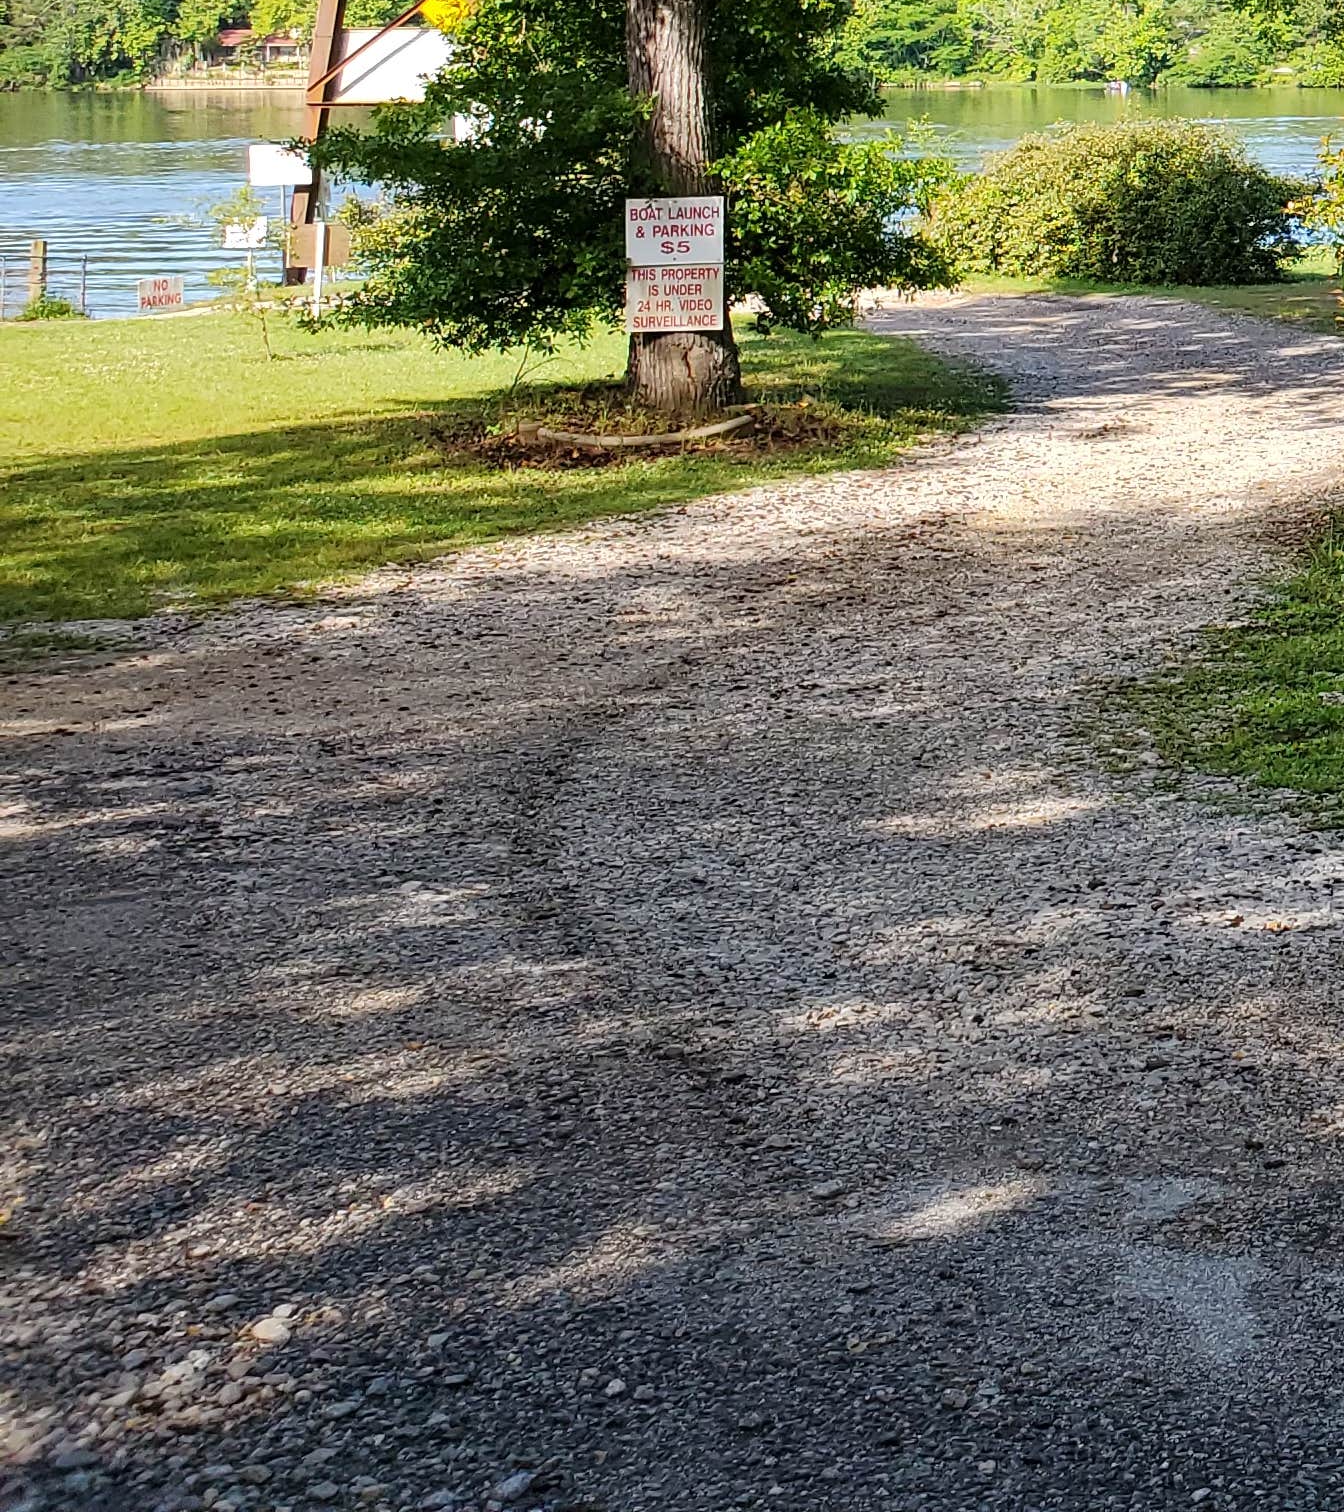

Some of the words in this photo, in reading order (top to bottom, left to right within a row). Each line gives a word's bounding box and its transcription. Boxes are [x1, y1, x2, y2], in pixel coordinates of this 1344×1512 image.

[630, 207, 663, 221] BOAT
[668, 206, 719, 220] LAUNCH
[636, 226, 645, 238] &
[653, 224, 714, 237] PARKING
[661, 241, 690, 254] $5
[632, 269, 656, 281] THIS
[662, 268, 719, 281] PROPERTY
[154, 279, 168, 291] NO
[649, 285, 659, 296] IS
[664, 284, 702, 296] UNDER
[141, 293, 181, 308] PARKING
[638, 301, 650, 312] 24
[656, 300, 674, 312] HR.
[679, 299, 712, 311] VIDEO
[633, 315, 717, 328] SURVEILLANCE
